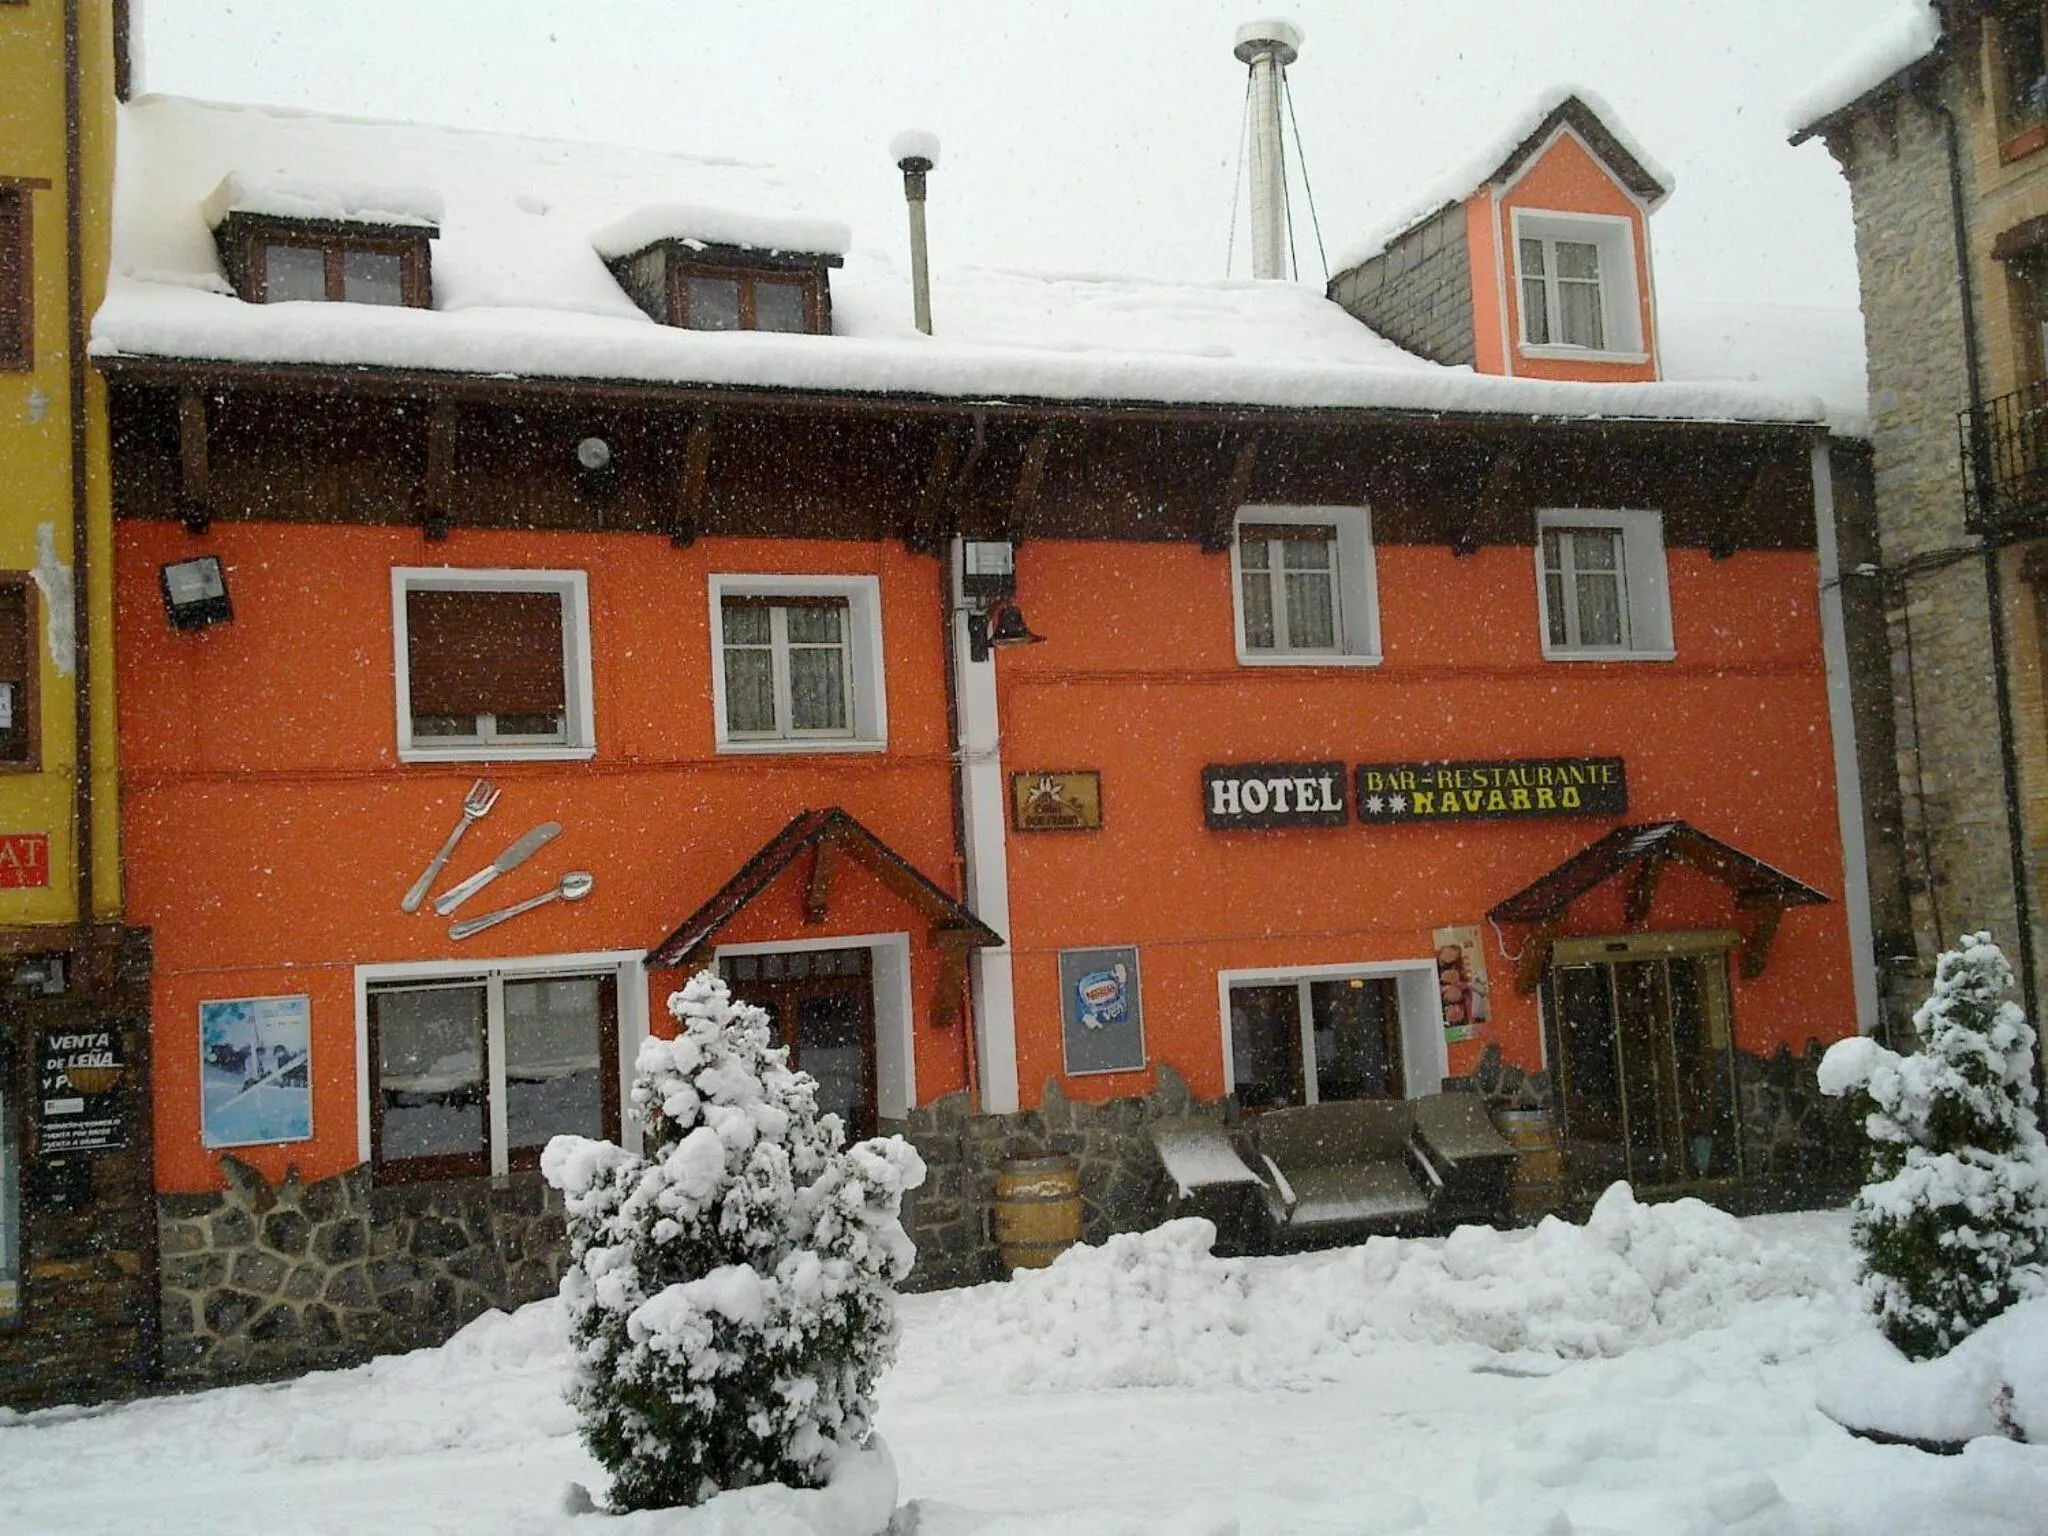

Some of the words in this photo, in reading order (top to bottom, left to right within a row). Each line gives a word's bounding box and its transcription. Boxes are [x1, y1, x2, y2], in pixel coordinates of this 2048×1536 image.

[1367, 765, 1617, 791] BAR-RESTAURANTE
[1211, 777, 1343, 814] HOTEL
[1413, 786, 1581, 814] NAVARRO
[50, 1033, 109, 1050] VENTA
[47, 1058, 66, 1070] DE
[67, 1048, 113, 1066] LEÑA
[42, 1078, 52, 1089] Y
